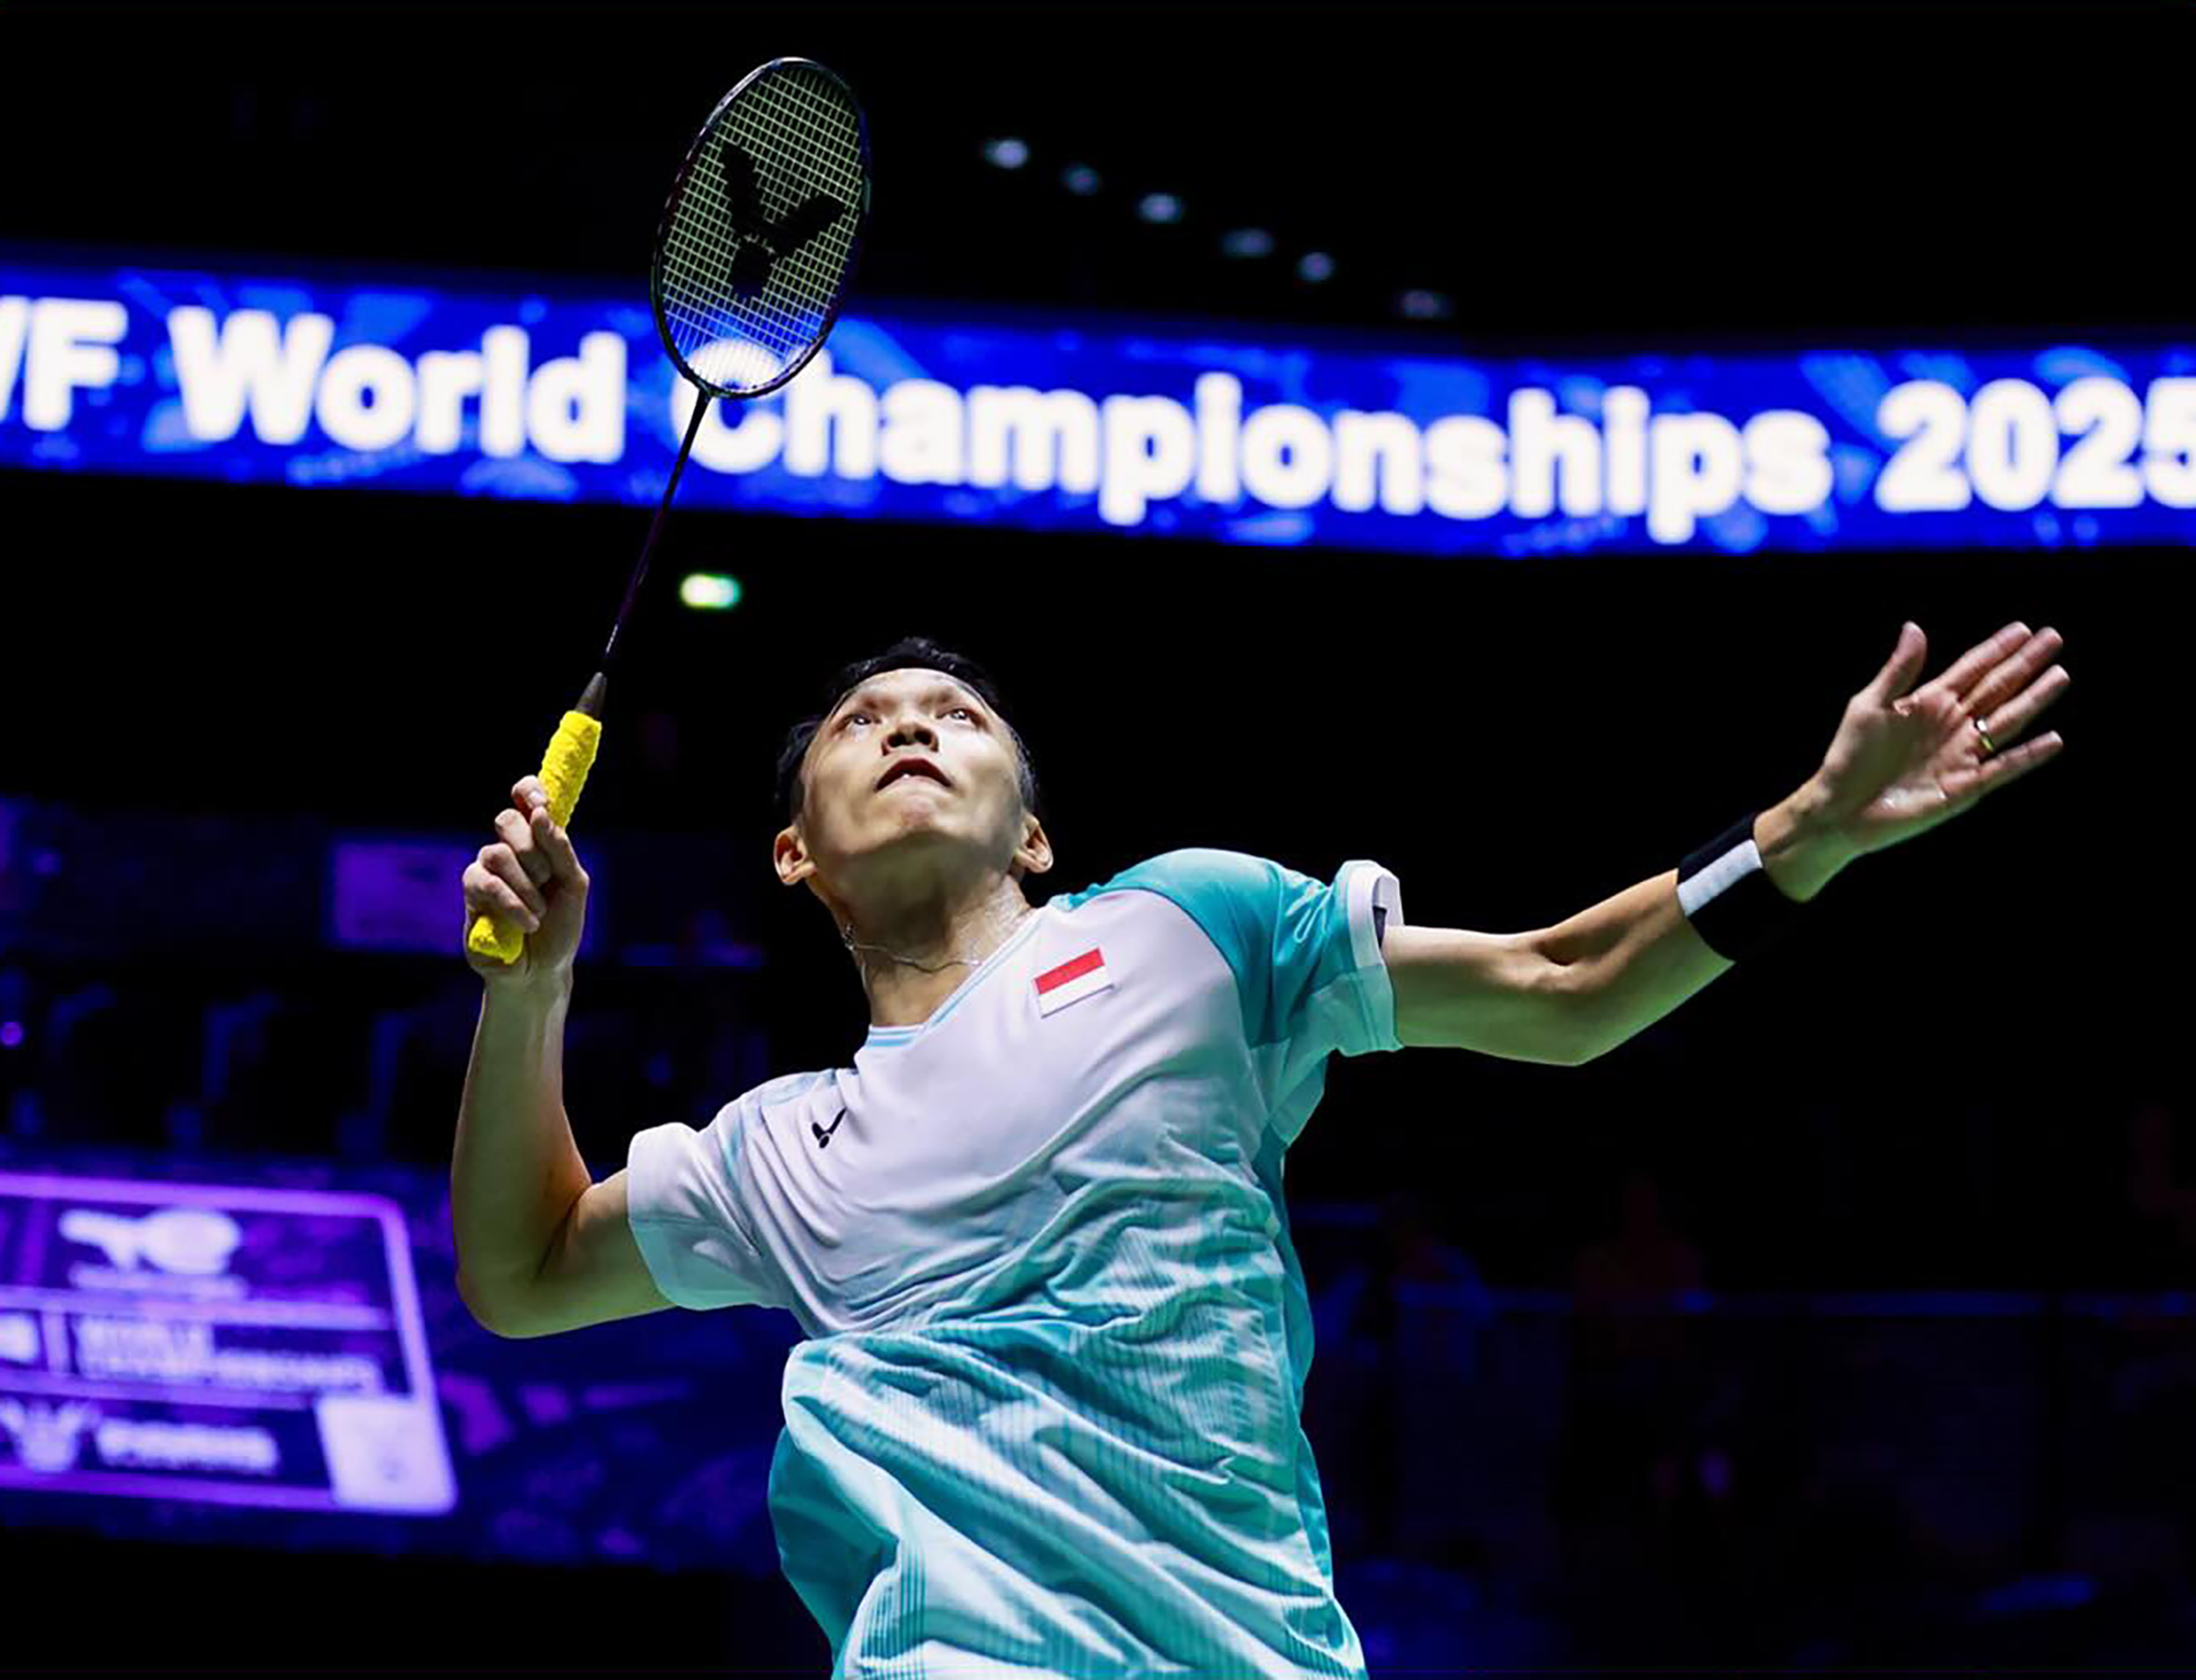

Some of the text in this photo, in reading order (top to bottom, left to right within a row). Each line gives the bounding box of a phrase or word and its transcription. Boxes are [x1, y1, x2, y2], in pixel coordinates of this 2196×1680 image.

[0, 296, 127, 431] F
[167, 306, 626, 463] World
[671, 337, 1834, 544] Championships
